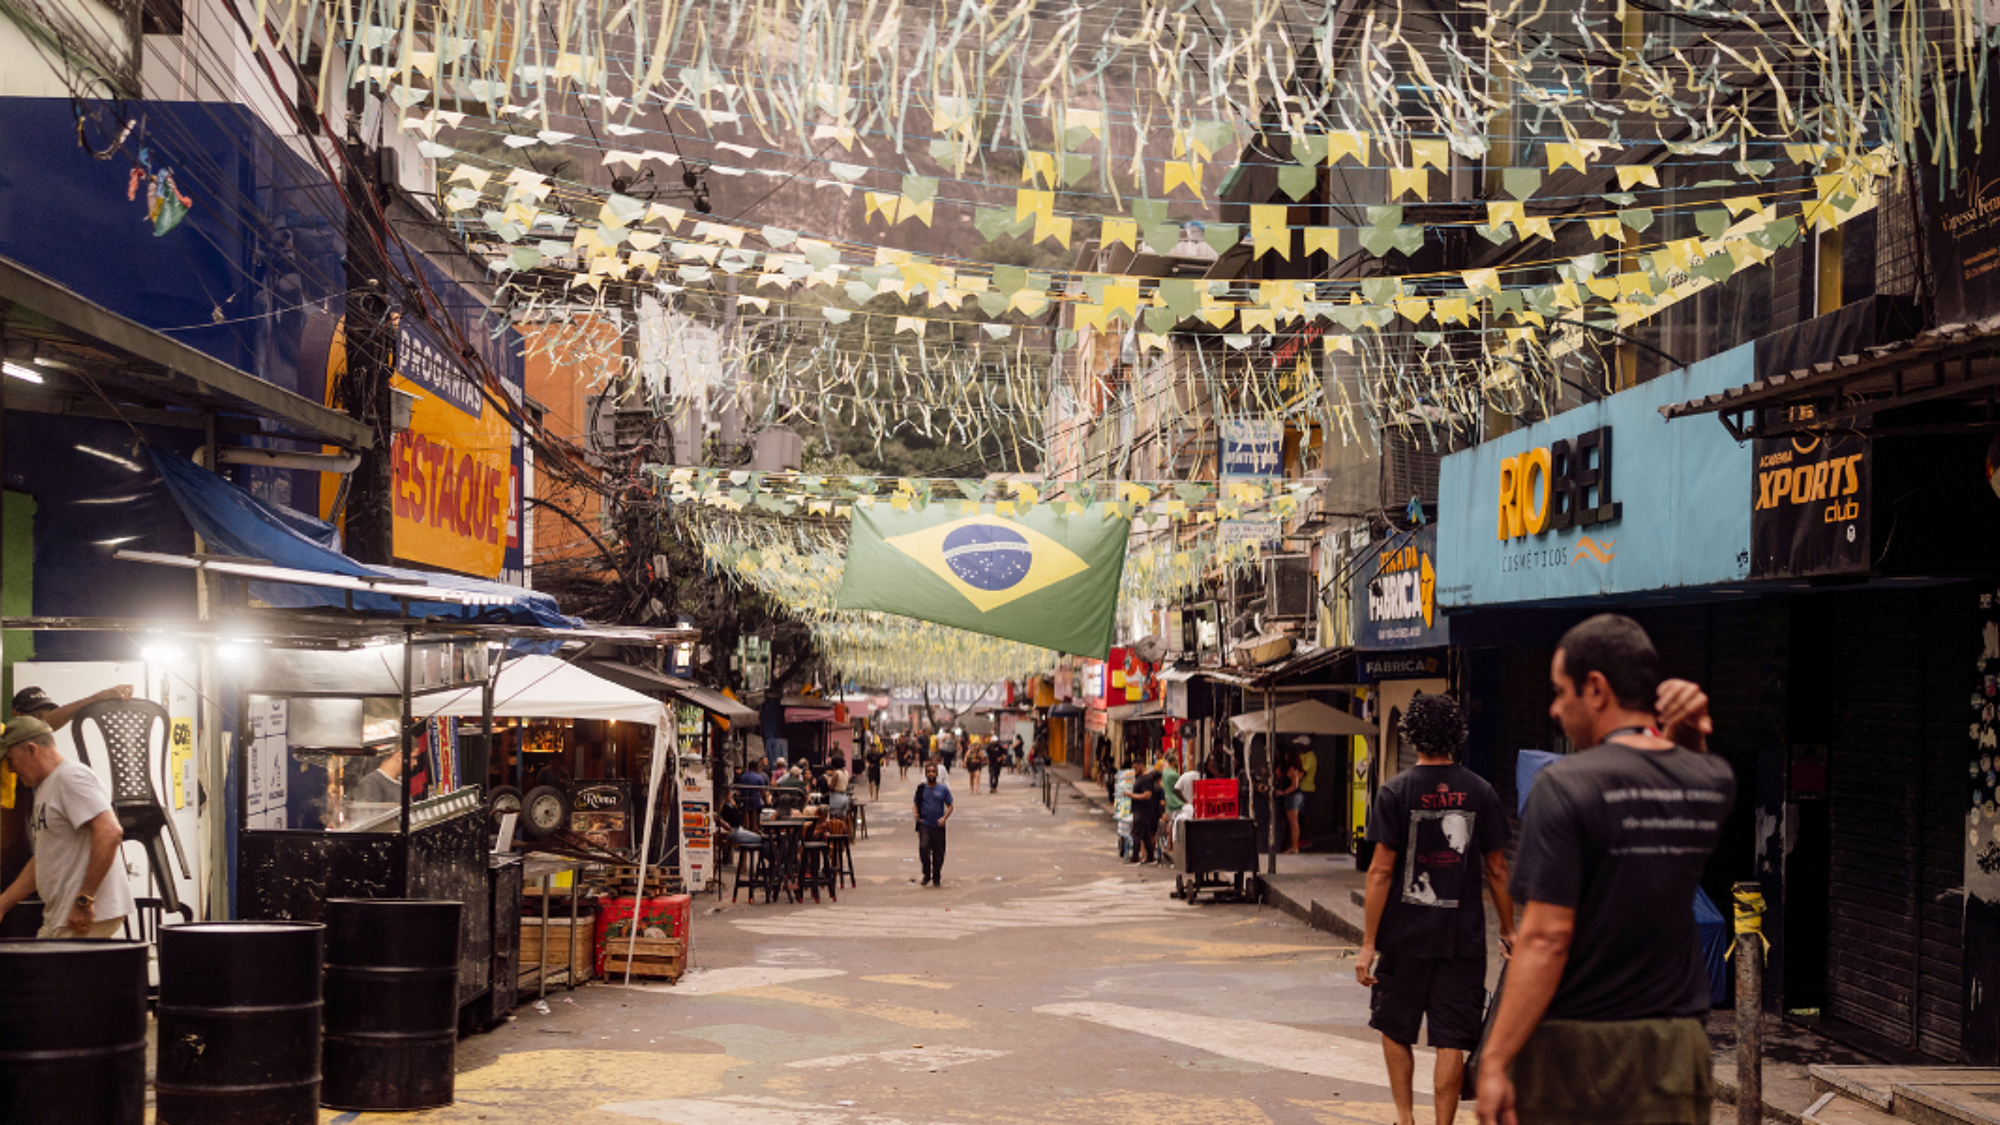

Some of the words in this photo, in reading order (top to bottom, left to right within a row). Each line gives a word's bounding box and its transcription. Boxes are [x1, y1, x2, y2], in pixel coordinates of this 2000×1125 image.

[400, 329, 481, 412] DROGARIAS
[1758, 450, 1794, 469] ACADEMIA
[391, 430, 502, 546] ESTAQUE
[1755, 453, 1863, 511] XPORTS
[1824, 498, 1859, 524] club
[1502, 547, 1567, 573] COSMÉTICOS
[1421, 792, 1467, 809] STAFF
